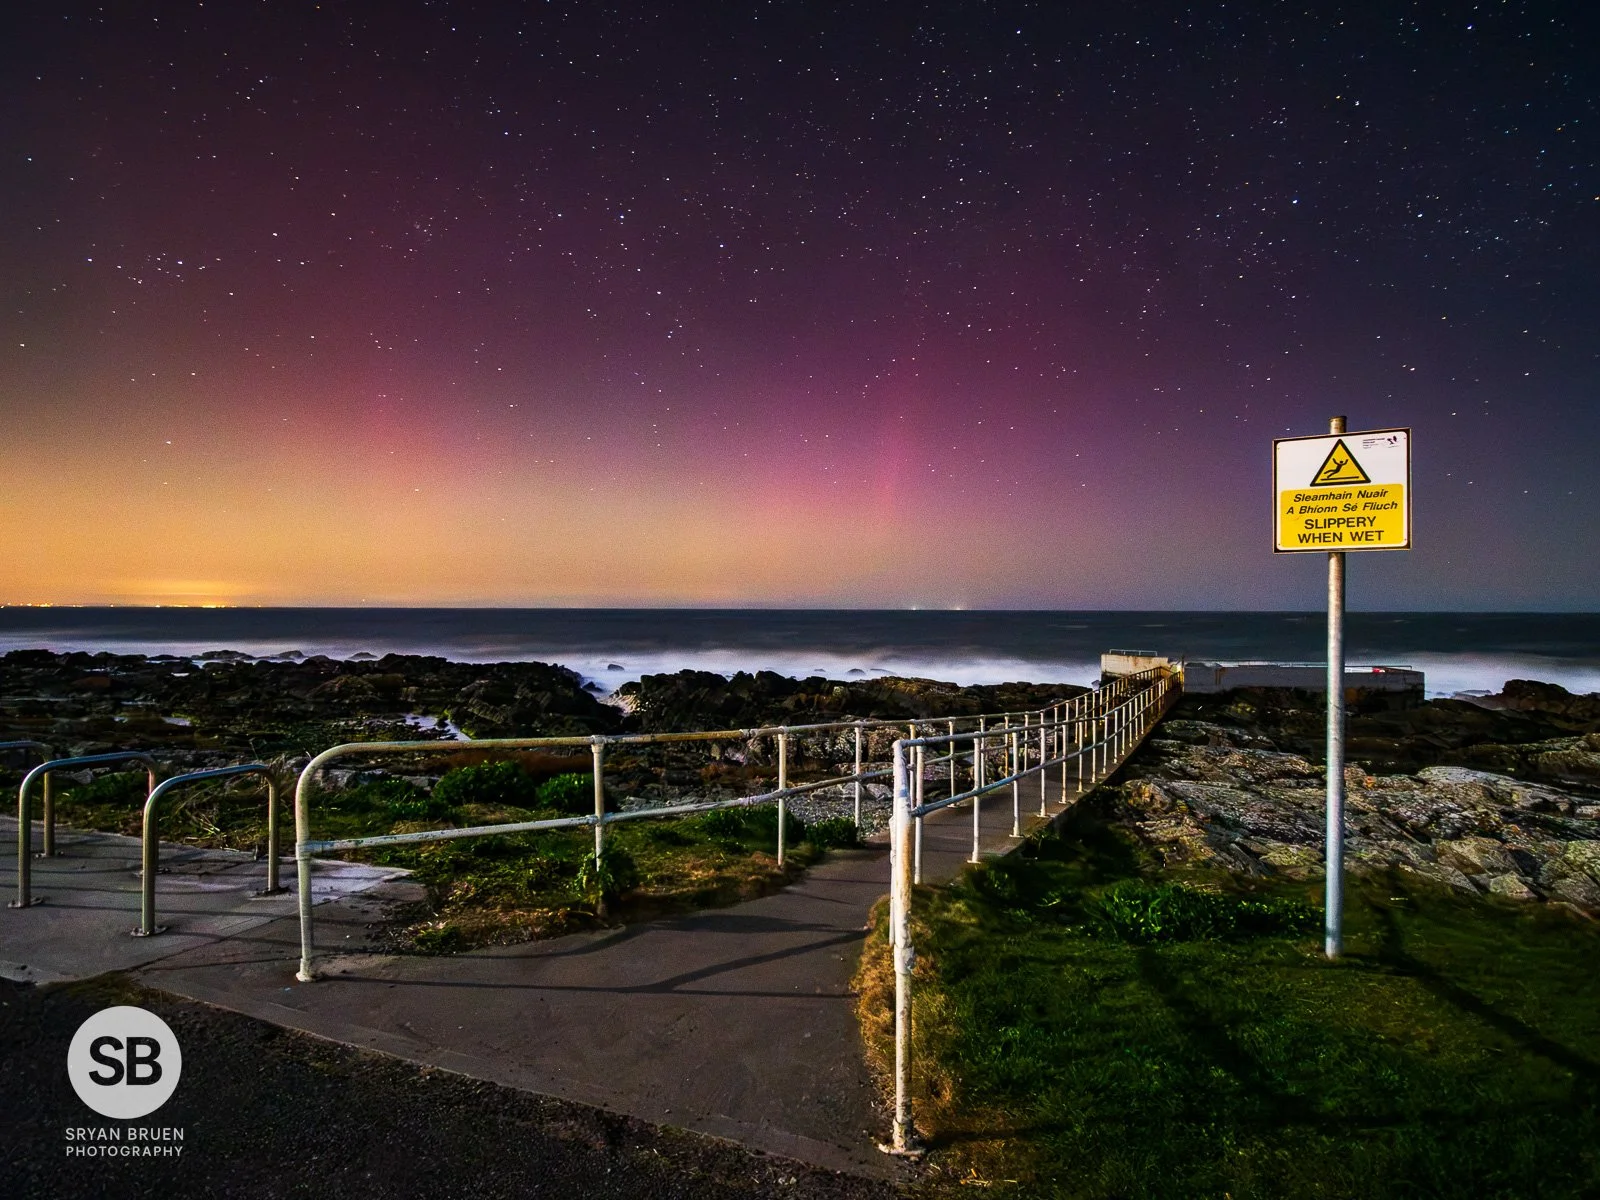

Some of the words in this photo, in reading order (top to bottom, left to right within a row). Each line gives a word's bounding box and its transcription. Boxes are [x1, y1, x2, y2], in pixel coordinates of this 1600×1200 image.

[1293, 491, 1352, 503] Sleamhain
[1357, 488, 1388, 499] Nuair
[1286, 506, 1294, 515] A
[1342, 502, 1358, 512] Sé
[1362, 500, 1398, 511] Fliuch
[1304, 515, 1377, 530] SLIPPERY
[1297, 532, 1343, 544] WHEN
[1350, 530, 1385, 541] WET
